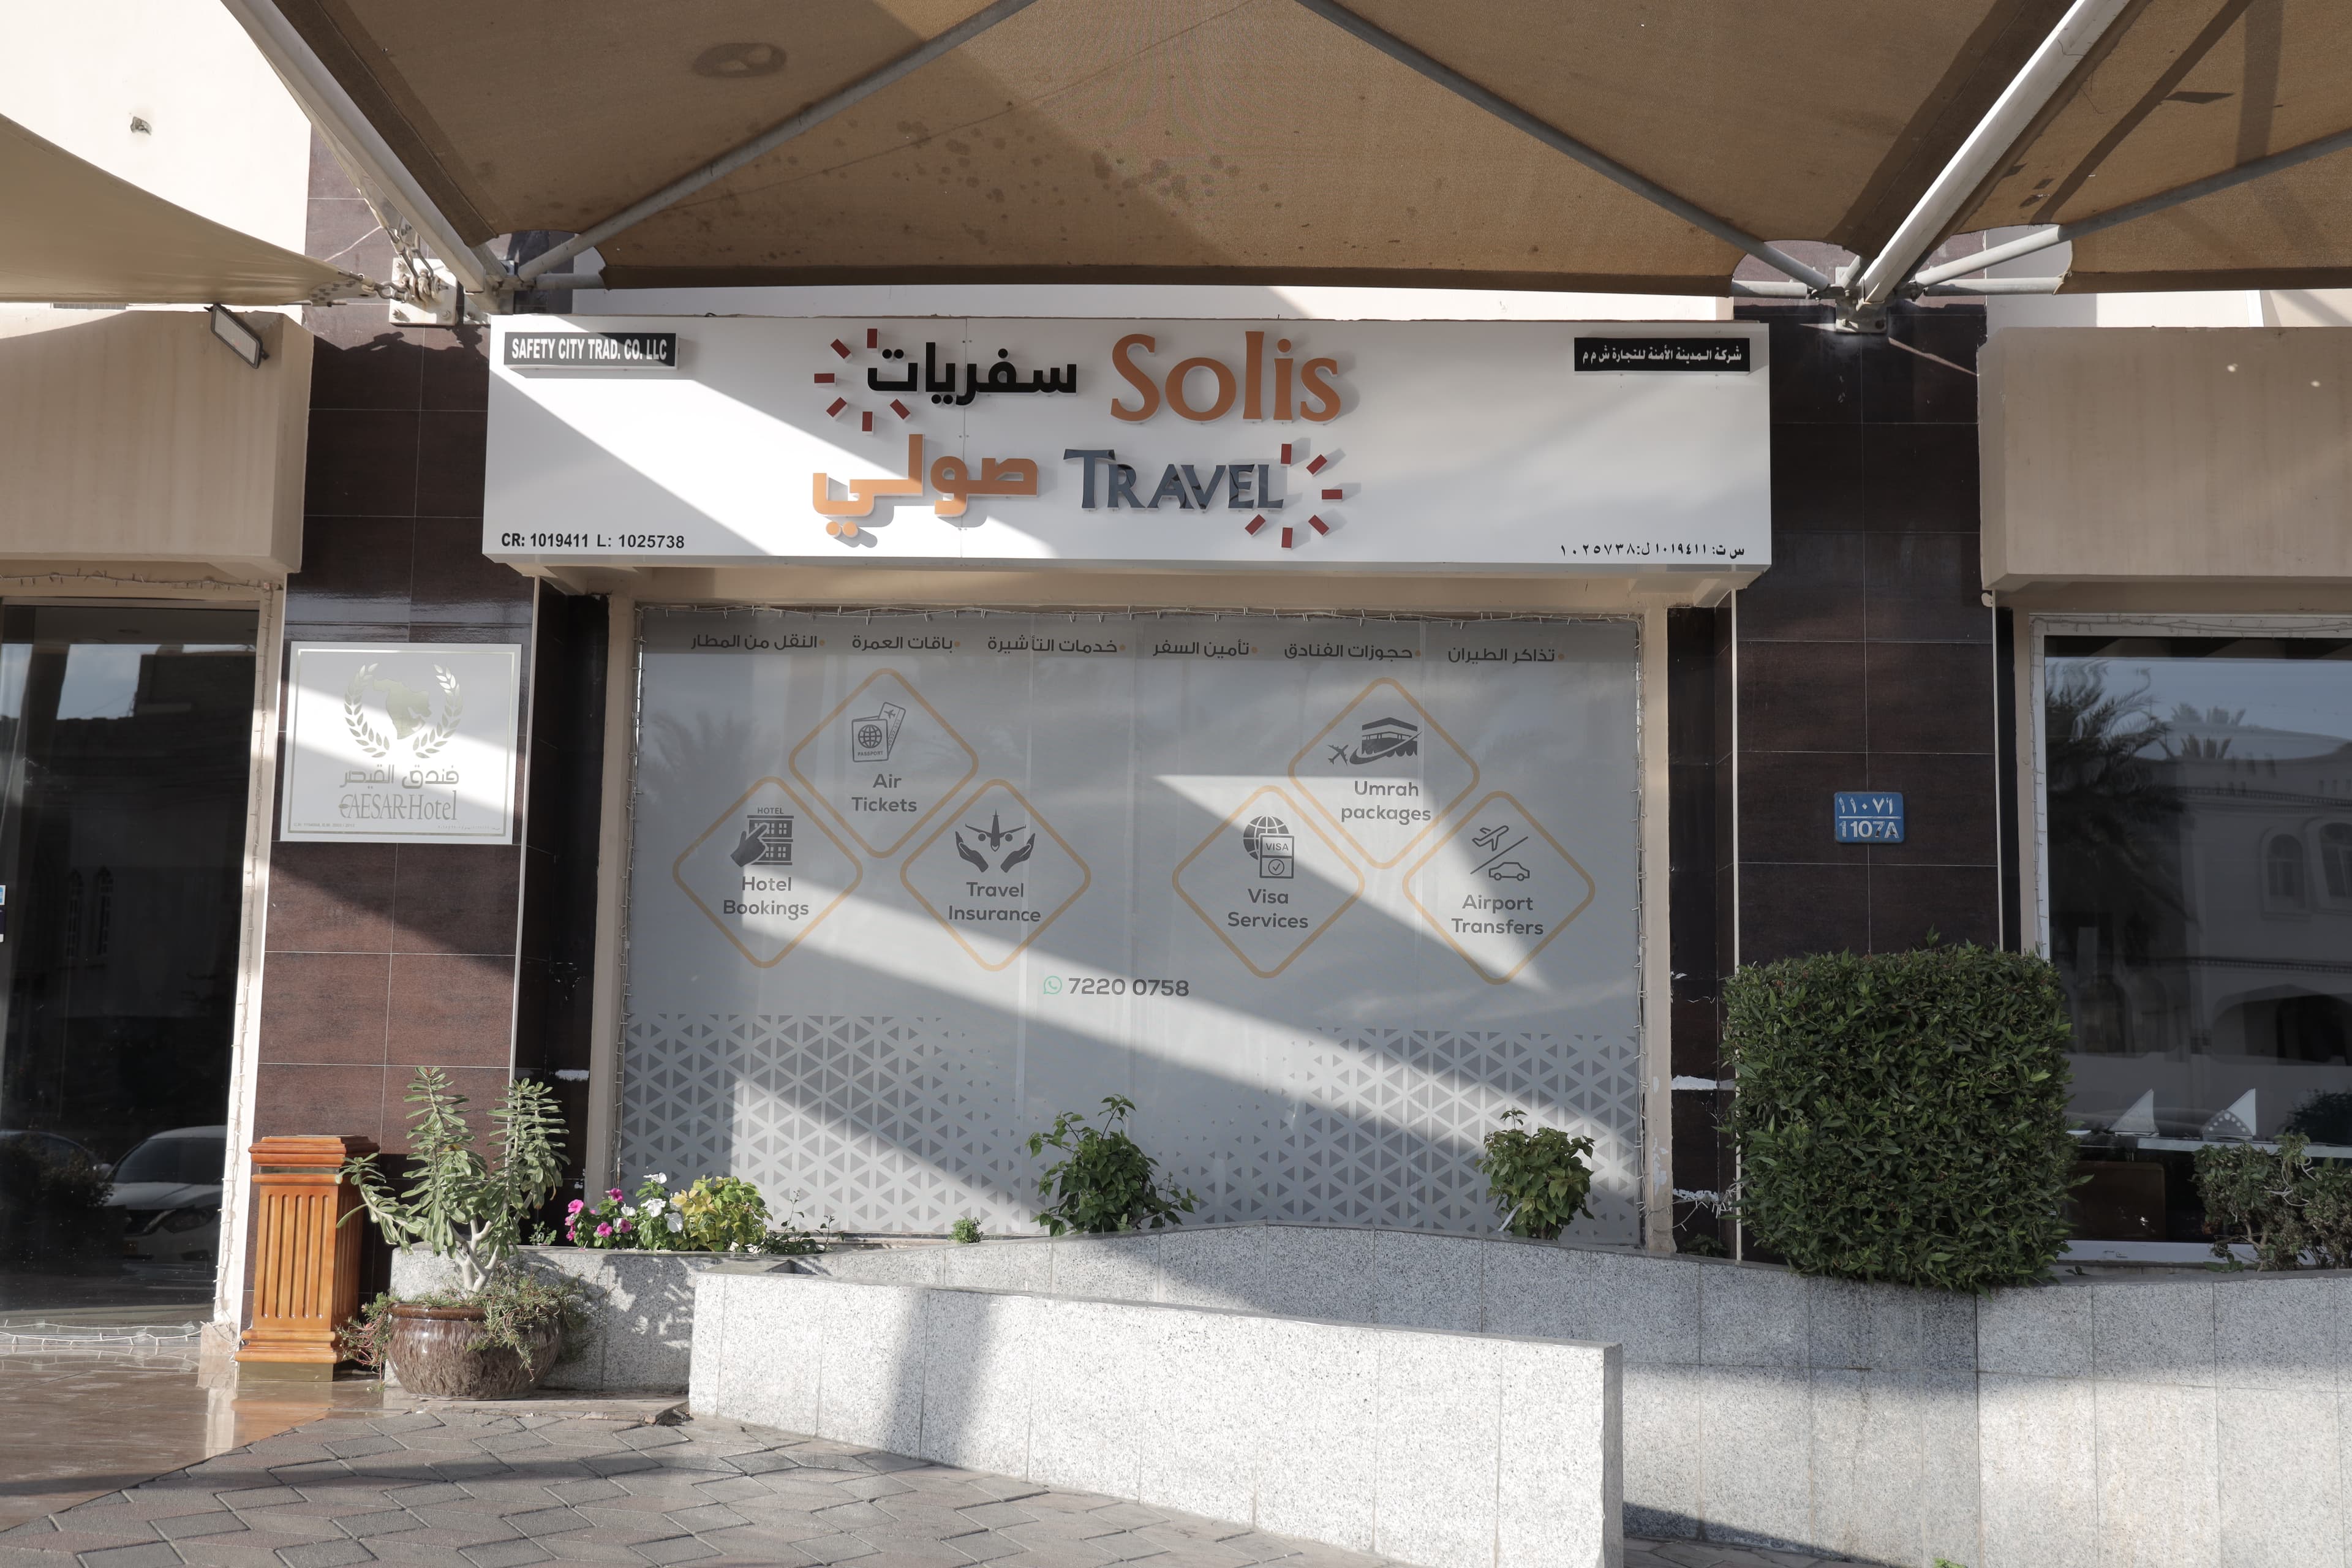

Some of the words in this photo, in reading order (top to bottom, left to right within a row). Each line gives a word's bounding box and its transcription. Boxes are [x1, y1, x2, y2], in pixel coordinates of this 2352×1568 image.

[512, 338, 556, 359] SAFETY
[558, 339, 585, 360] CITY
[588, 339, 620, 360] TRAD.
[624, 339, 643, 360] CO.
[646, 339, 667, 360] LLC
[1583, 350, 1588, 364] م
[1591, 350, 1596, 364] م
[1599, 345, 1610, 362] ش
[1613, 347, 1645, 363] للتجارة
[1676, 347, 1712, 364] المدينة
[1714, 345, 1742, 363] شركة
[867, 342, 1077, 405] سفريات
[1110, 331, 1341, 423] Solis
[813, 434, 1038, 539] صولي
[1063, 449, 1284, 513] TRAVEL
[501, 533, 525, 547] CR:
[530, 533, 589, 548] 1019411
[597, 534, 611, 547] L:
[618, 535, 685, 549] 1025738
[690, 633, 740, 649] المطار
[745, 635, 769, 650] من
[774, 633, 817, 650] النقل
[852, 635, 903, 650] العمرة
[908, 635, 953, 654] باقات
[987, 635, 1054, 654] التأشيرة
[1059, 639, 1117, 653] خدمات
[1153, 639, 1199, 657] السفر
[1204, 639, 1250, 658] تأمين
[1284, 643, 1343, 659] الفنادق
[1348, 645, 1413, 662] حجوزات
[1447, 647, 1507, 665] الطيران
[1512, 648, 1555, 663] تذاكر
[339, 764, 394, 789] القيصر
[402, 765, 459, 789] فندق
[873, 774, 902, 789] Air
[1354, 780, 1419, 797] Umrah
[338, 793, 407, 820] CAESAR
[408, 790, 457, 820] Hotel
[851, 797, 918, 813] Tickets
[1341, 805, 1431, 825] packages
[1839, 820, 1899, 838] 1107A
[1265, 843, 1289, 852] VISA
[742, 876, 792, 892] Hotel
[966, 881, 1024, 898] Travel
[1247, 888, 1289, 905] Visa
[1462, 894, 1534, 914] Airport
[723, 900, 809, 921] Bookings
[948, 906, 1041, 922] Insurance
[1227, 912, 1309, 929] Services
[1451, 918, 1544, 935] Transfers
[1068, 978, 1126, 995] 7220
[1133, 979, 1189, 997] 0758
